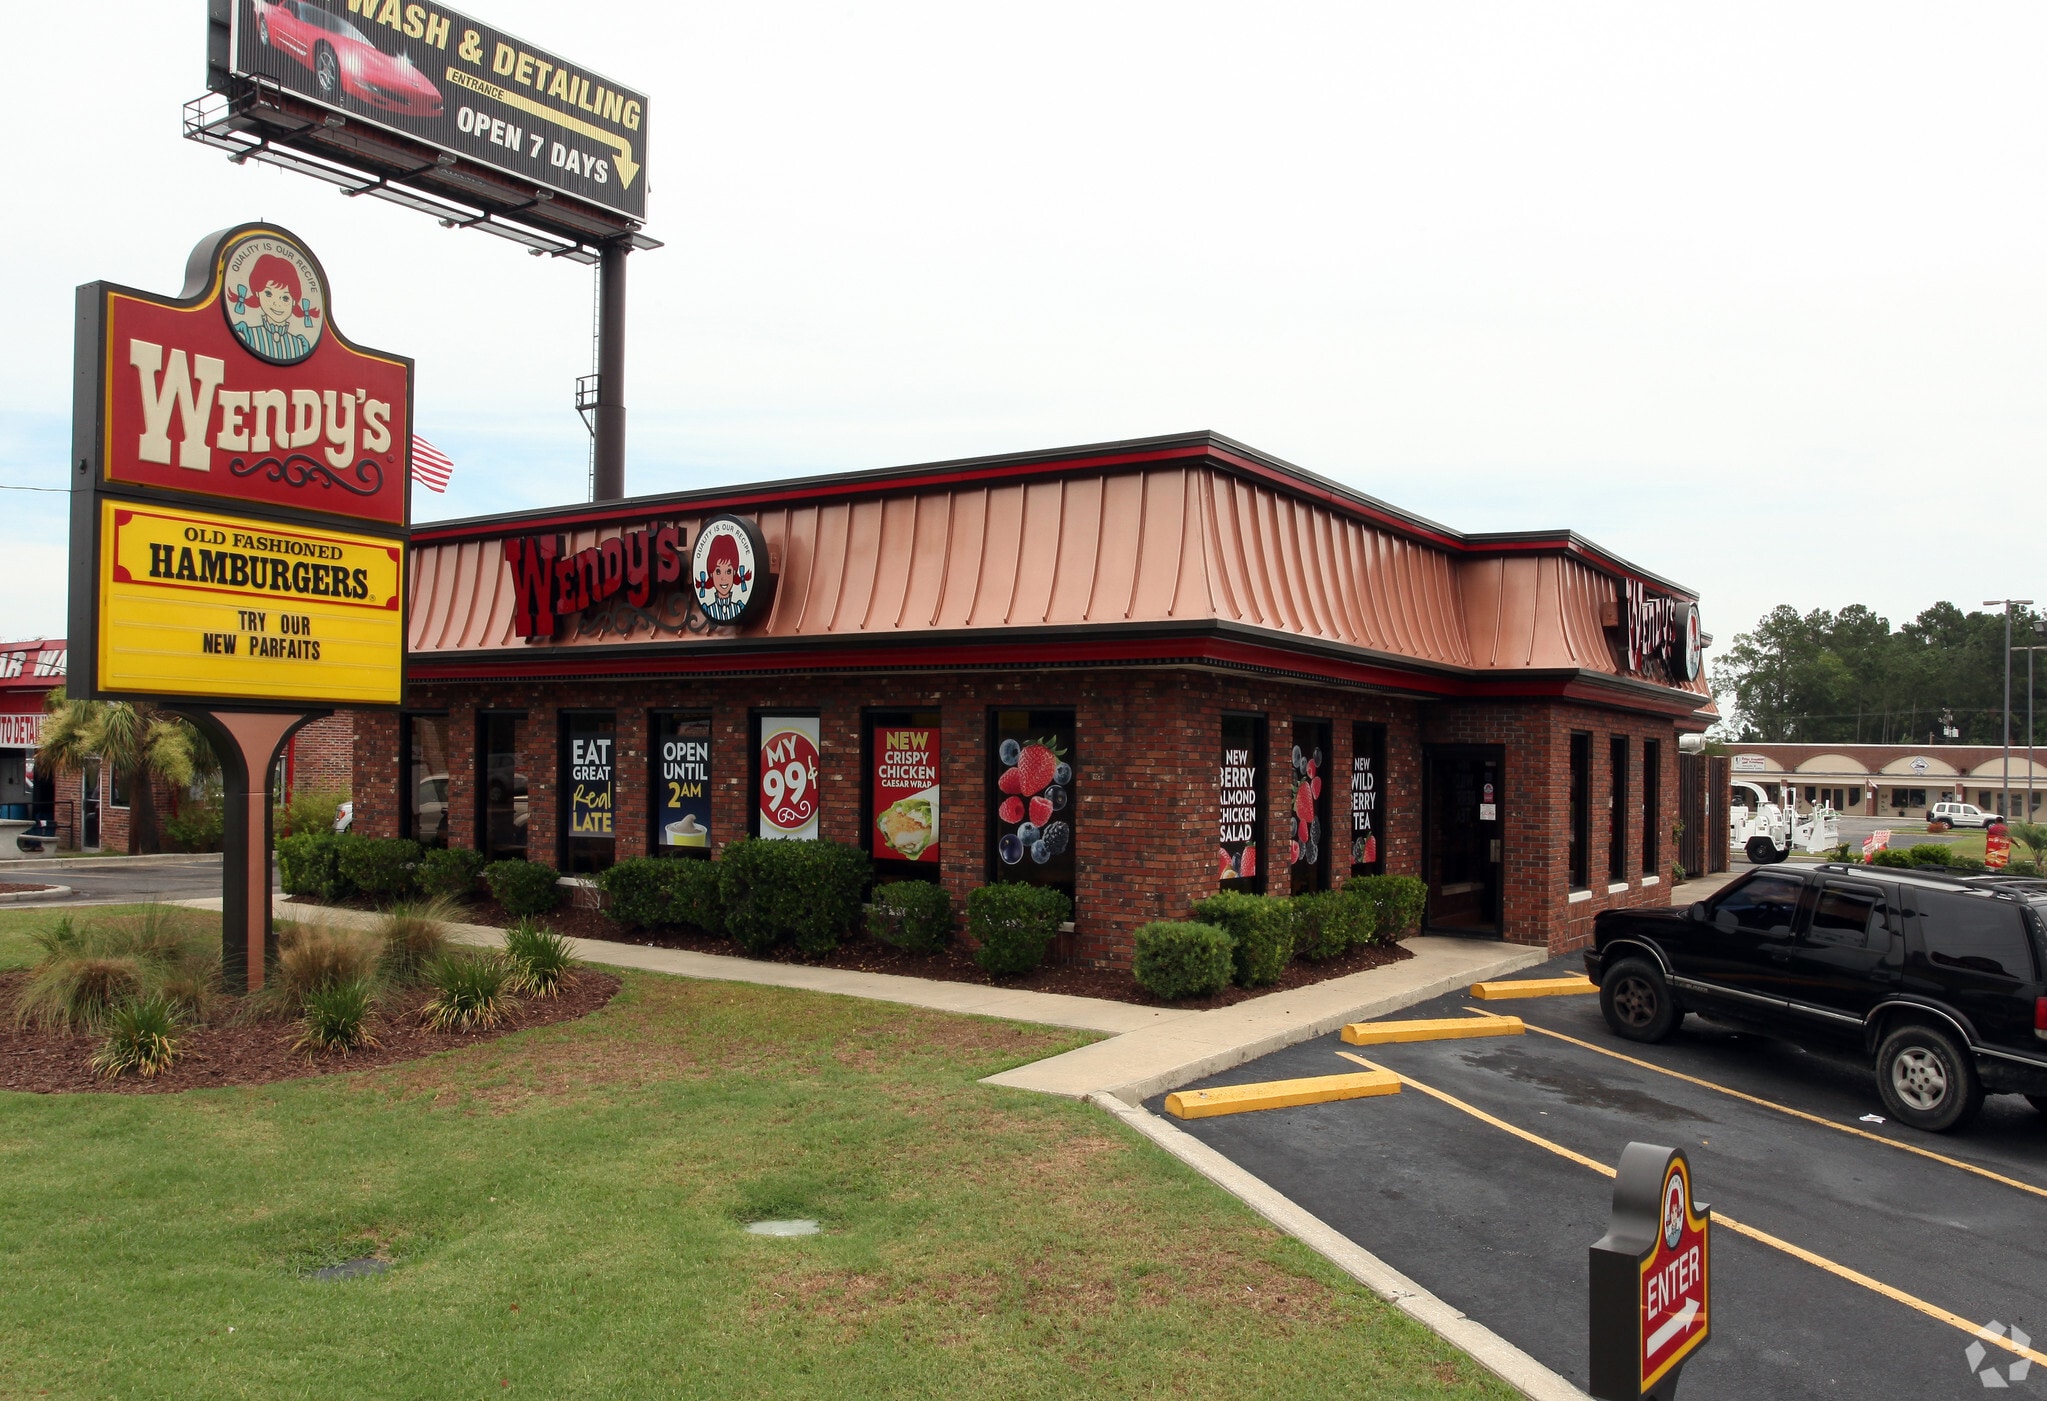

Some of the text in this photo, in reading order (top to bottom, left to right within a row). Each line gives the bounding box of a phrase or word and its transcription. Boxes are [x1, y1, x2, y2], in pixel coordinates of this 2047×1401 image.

[451, 72, 505, 100] ENTRANCE
[459, 30, 483, 65] &
[493, 42, 641, 131] DETAILING
[457, 107, 609, 184] OPEN 7 DAYS
[232, 243, 318, 293] QUALITY IS OUR RECIPE
[184, 527, 343, 560] OLD FASHIONED
[696, 529, 713, 559] QUALITY
[722, 523, 735, 532] OUR
[735, 529, 751, 556] RECIPE
[150, 543, 369, 601] HAMBURGERS
[238, 611, 311, 636] TRY OUR
[203, 633, 320, 661] NEW PARFAITS
[886, 731, 929, 750] NEW
[572, 739, 611, 765] EAT
[663, 742, 708, 761] OPEN
[765, 735, 797, 768] MY
[885, 751, 929, 765] CRISPY
[1226, 749, 1248, 765] NEW
[572, 766, 611, 781] GREAT
[663, 763, 708, 781] UNTIL
[878, 766, 936, 780] CHICKEN
[1354, 757, 1371, 771] NEW
[881, 779, 932, 788] CAESAR WRAP
[1351, 772, 1374, 791] WILD
[573, 781, 612, 811] Real
[1351, 791, 1376, 811] ERRY
[573, 812, 612, 832] LATE
[1353, 811, 1371, 831] TEA
[1219, 823, 1252, 842] SALAD
[1647, 1245, 1700, 1321] ENTER
